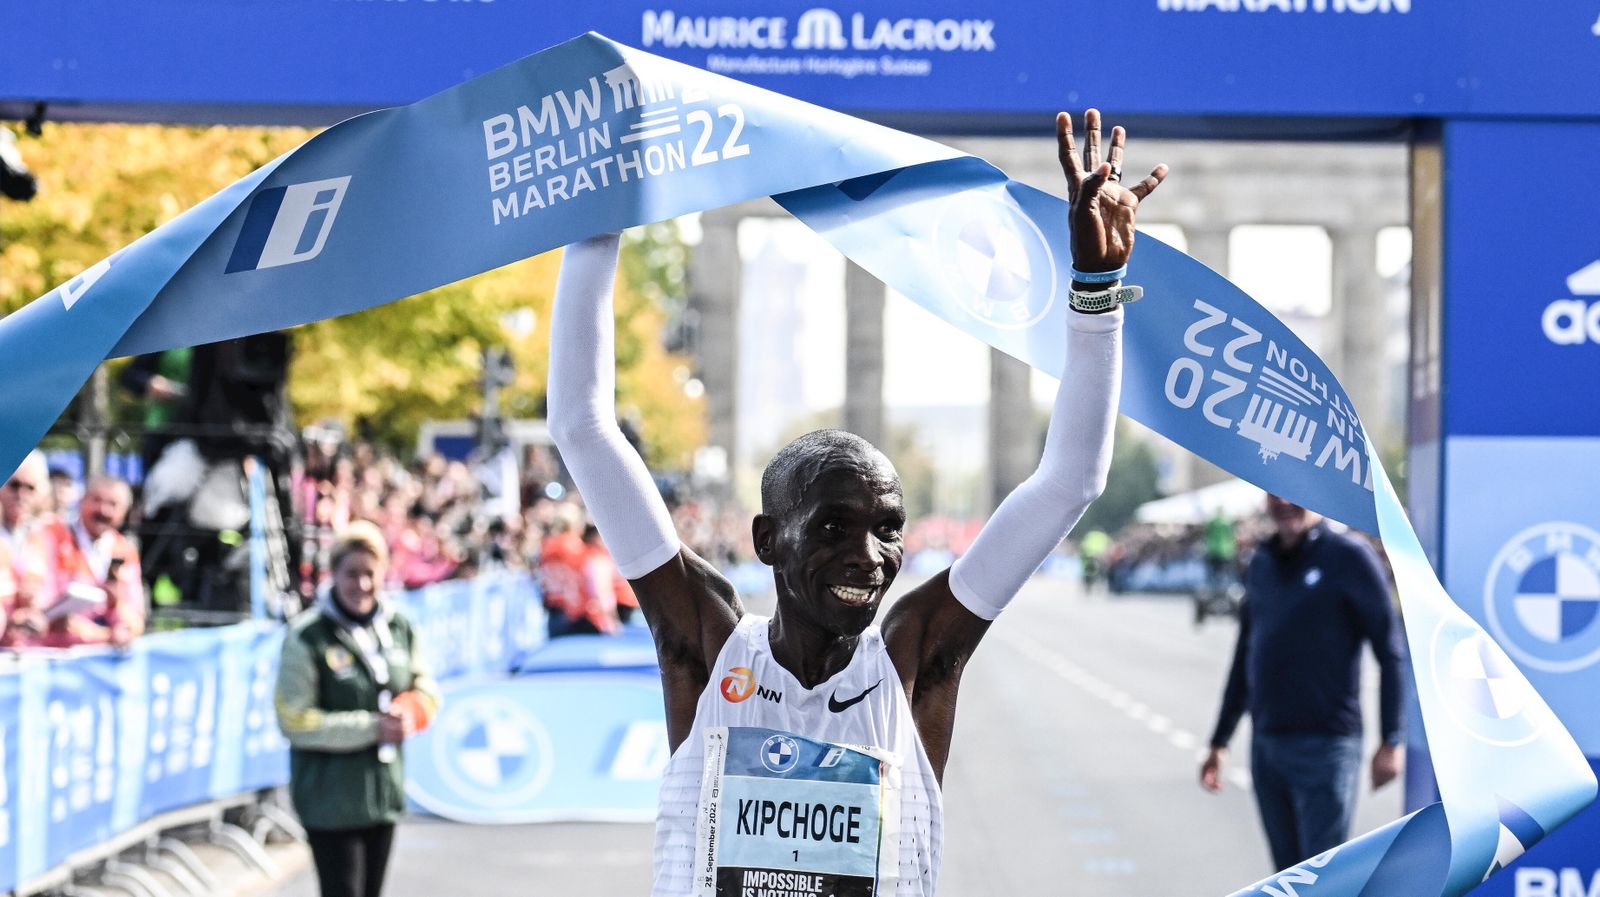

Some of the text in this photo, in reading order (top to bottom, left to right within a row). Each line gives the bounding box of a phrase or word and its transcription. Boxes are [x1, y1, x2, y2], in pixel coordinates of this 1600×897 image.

[642, 10, 787, 48] MAURICE
[852, 12, 995, 50] LACROIX
[483, 76, 600, 160] BMW
[489, 121, 612, 193] BERLIN
[492, 103, 750, 225] MARATHON 22
[1183, 298, 1263, 373] 22
[1164, 357, 1247, 429] 20
[757, 685, 782, 704] NN
[709, 802, 717, 824] 2022
[736, 799, 862, 844] KIPCHOGE
[706, 826, 715, 873] September
[792, 850, 799, 862] 1
[743, 870, 824, 893] IMPOSSIBLE
